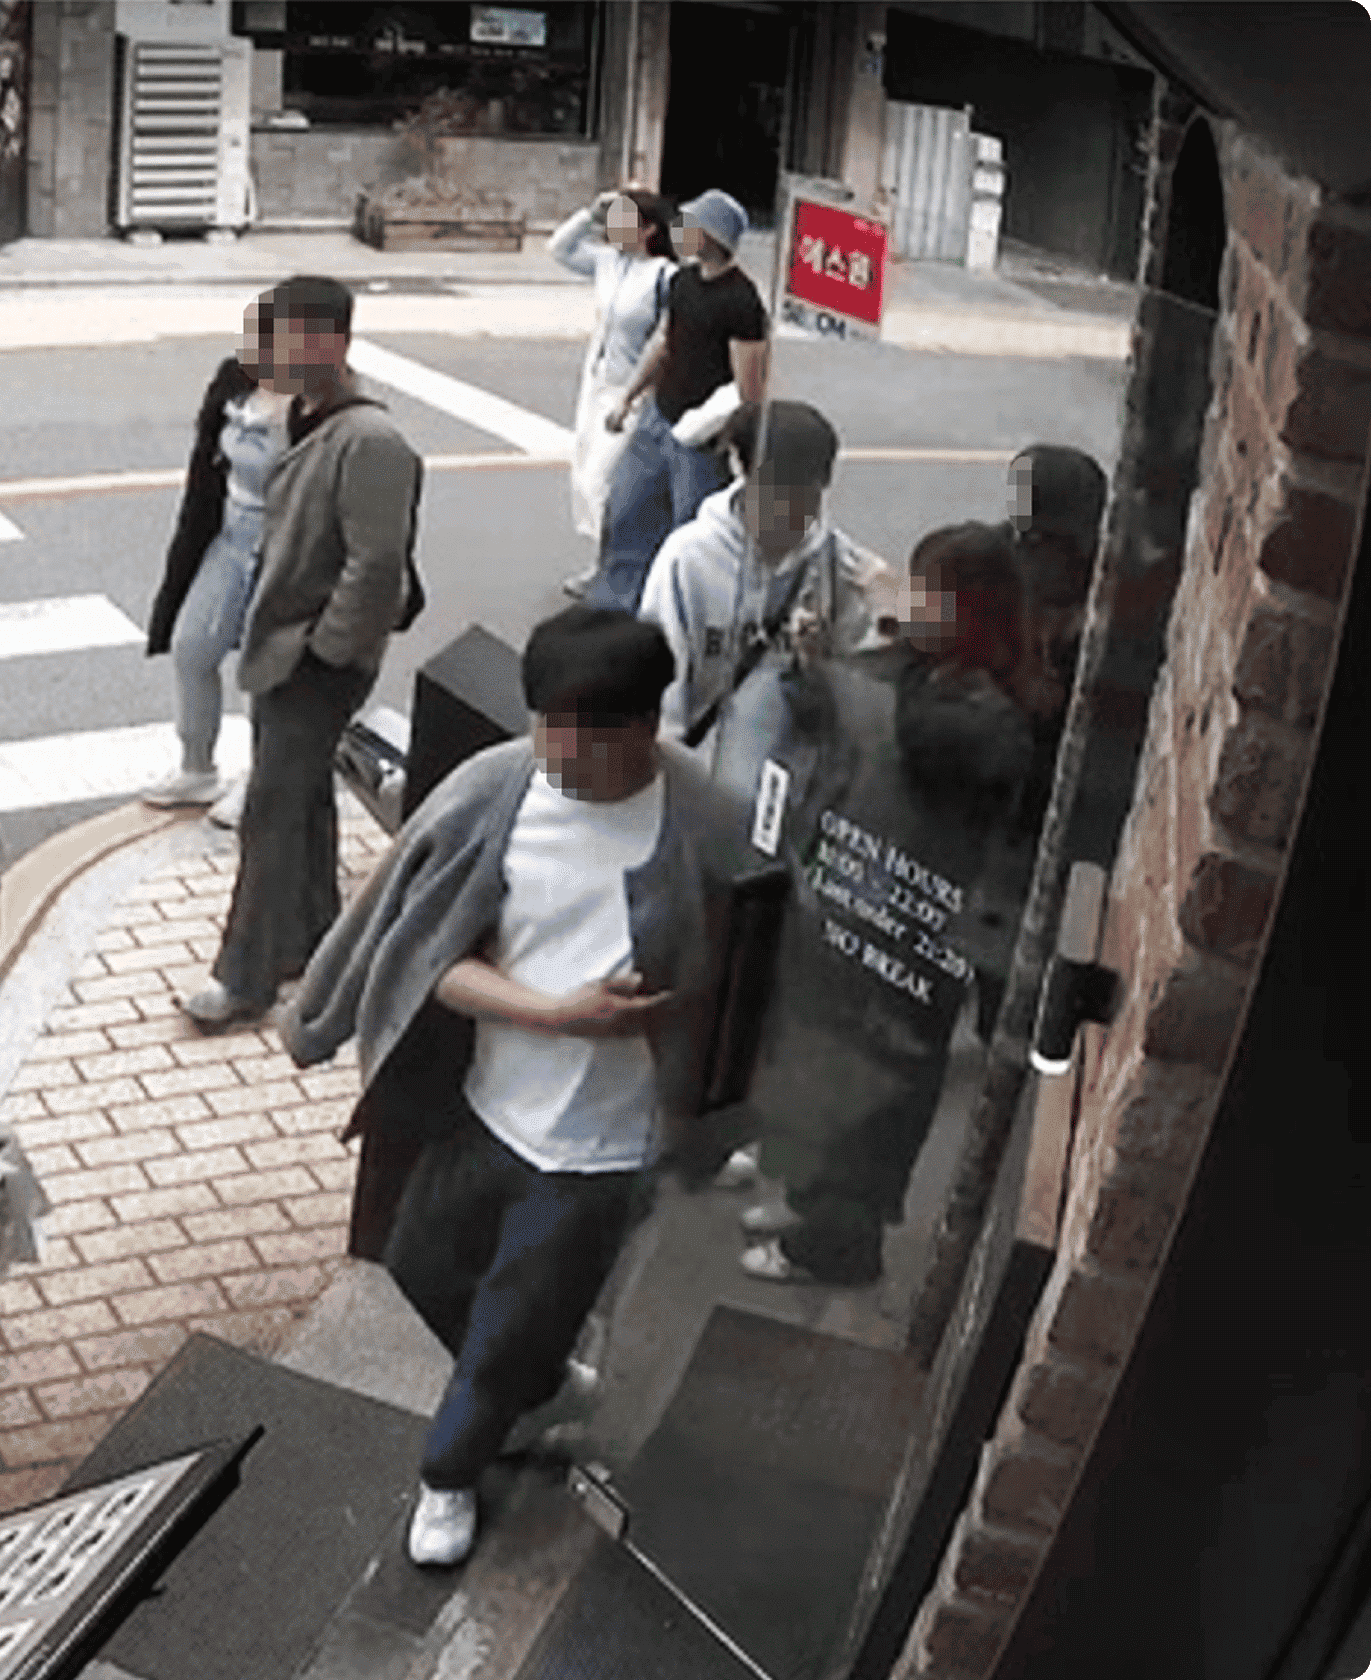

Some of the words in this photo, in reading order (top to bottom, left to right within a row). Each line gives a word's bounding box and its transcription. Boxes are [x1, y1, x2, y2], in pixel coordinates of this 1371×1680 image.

[821, 810, 882, 860] OPEN
[885, 846, 963, 914] HOURS
[823, 918, 861, 956] NO
[862, 943, 932, 1005] BREAK
